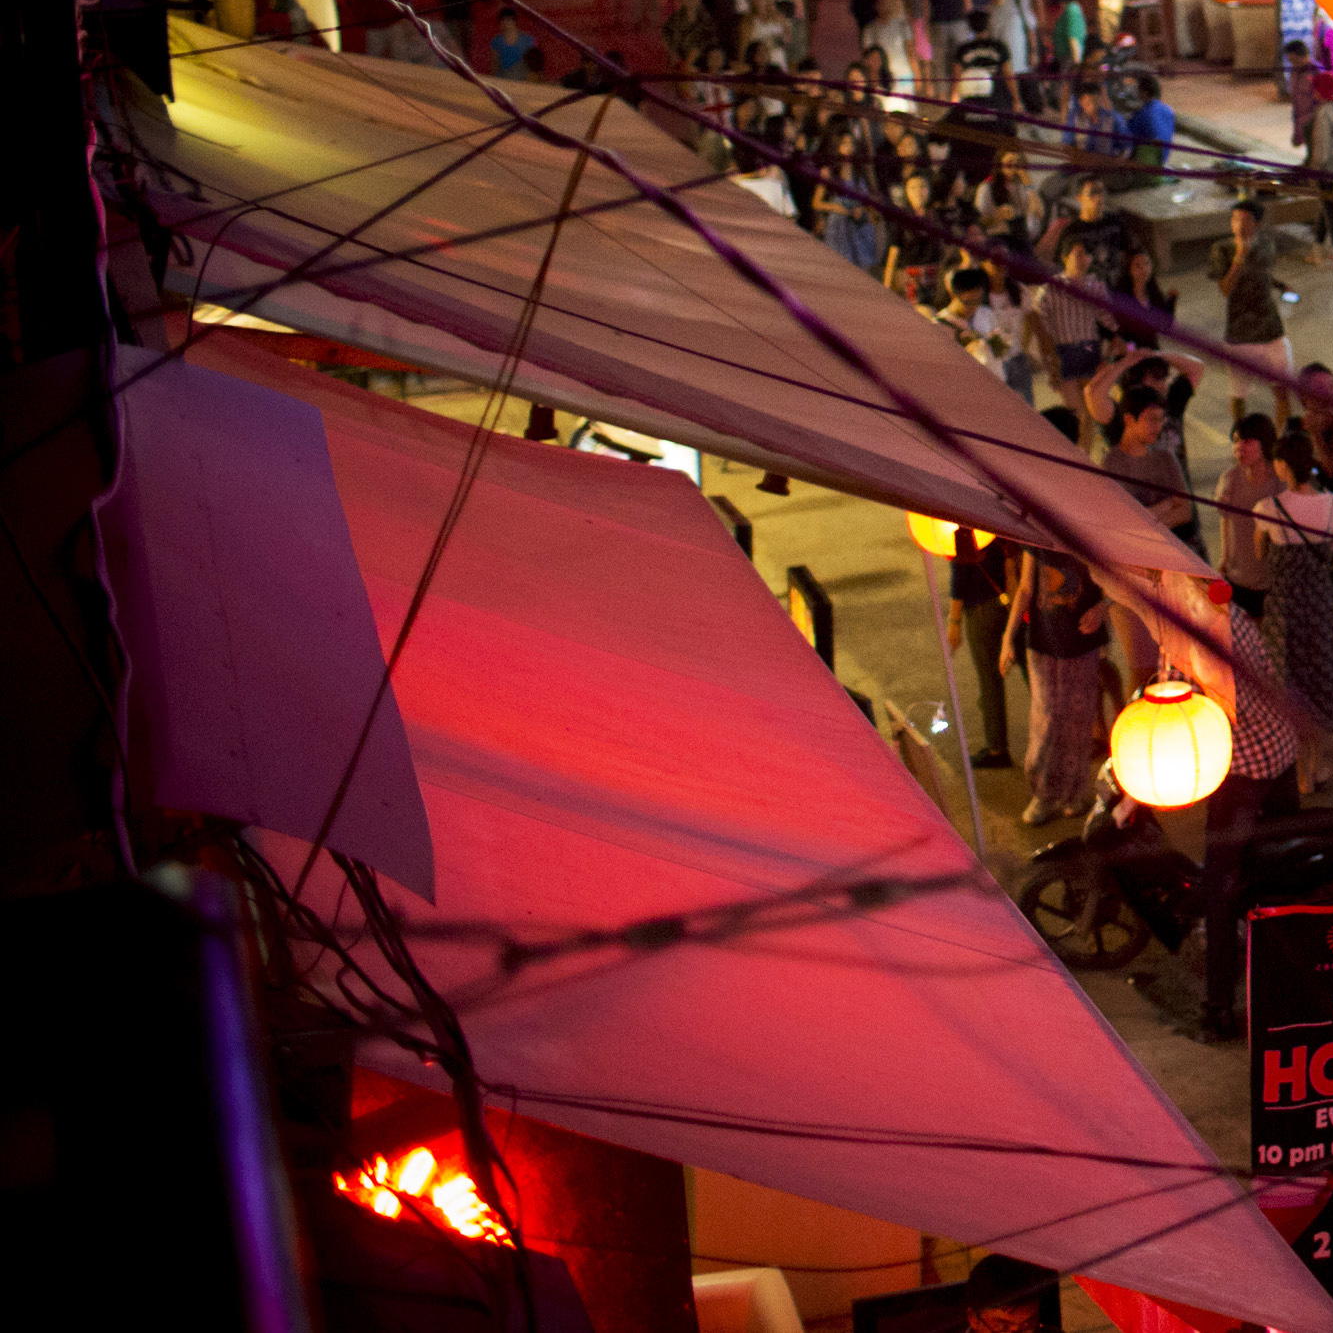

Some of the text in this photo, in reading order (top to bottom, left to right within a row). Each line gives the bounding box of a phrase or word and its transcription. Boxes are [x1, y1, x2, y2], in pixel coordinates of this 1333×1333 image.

[1257, 1144, 1283, 1166] 10
[1289, 1142, 1325, 1167] pm
[1313, 1231, 1331, 1259] 2
